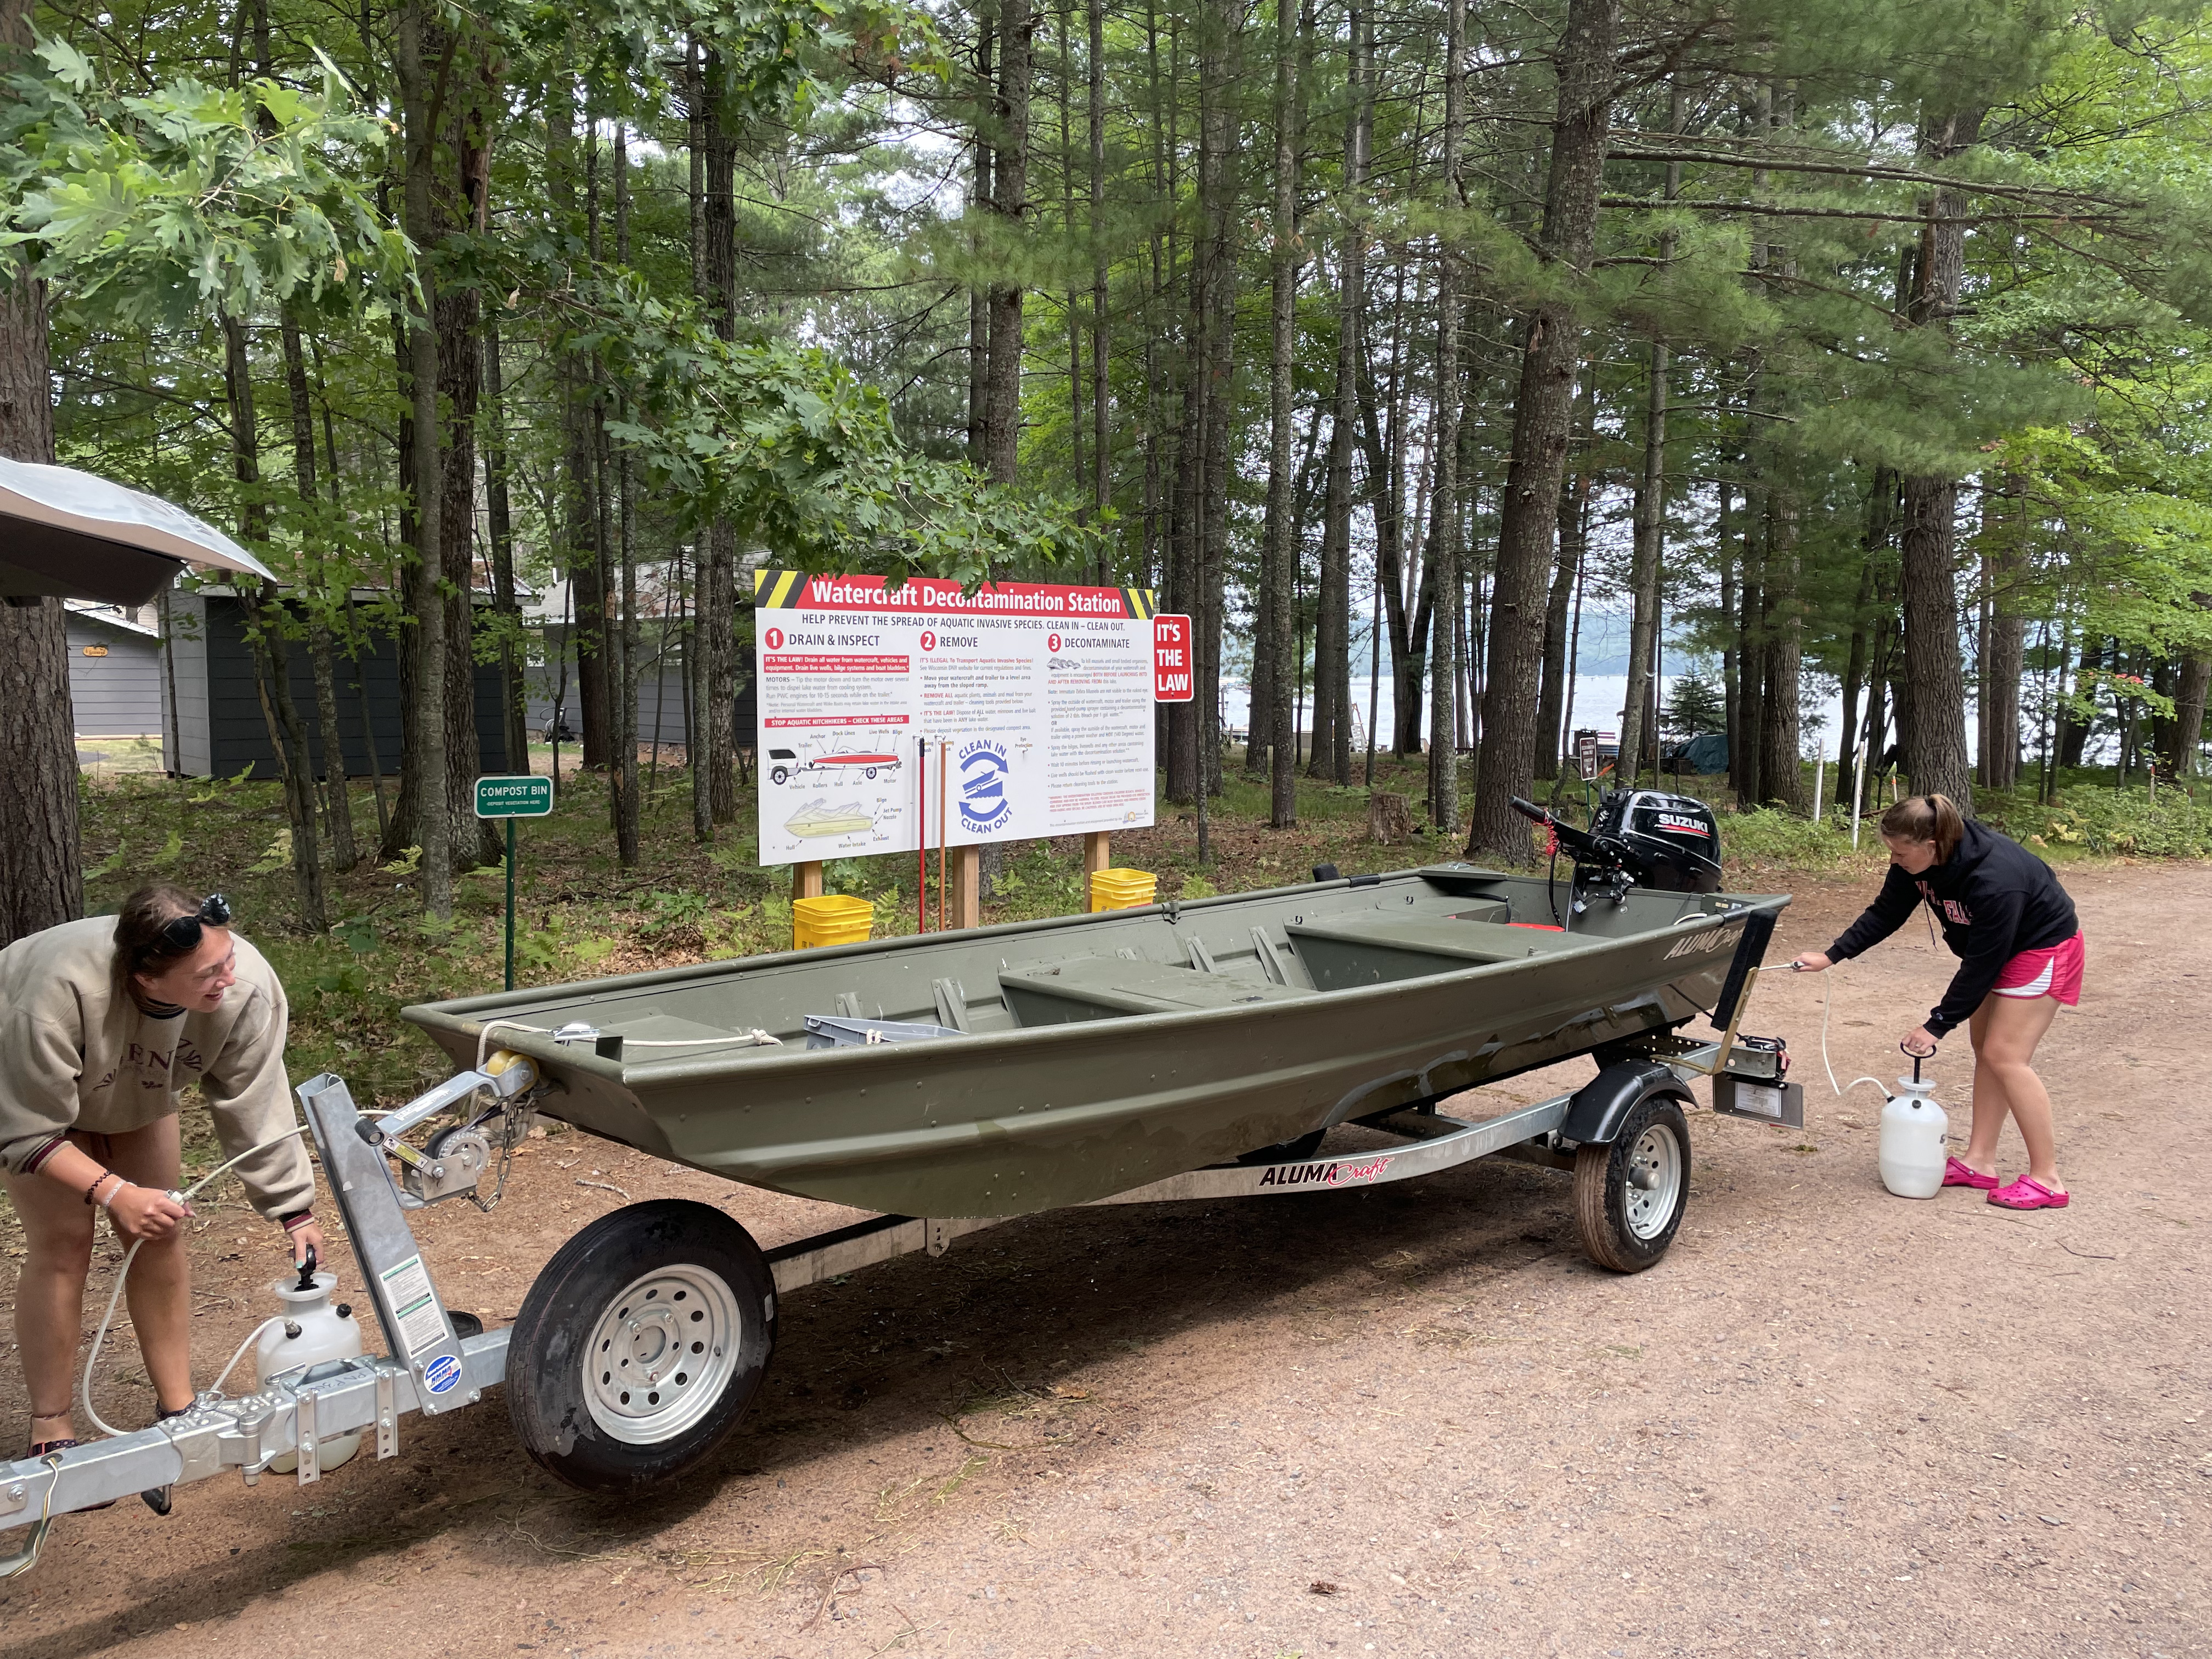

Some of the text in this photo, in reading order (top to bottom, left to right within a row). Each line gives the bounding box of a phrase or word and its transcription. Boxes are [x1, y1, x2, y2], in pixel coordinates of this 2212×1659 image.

[812, 582, 917, 606] Watercraft
[1069, 592, 1120, 613] Station
[802, 614, 825, 624] HELP
[829, 614, 869, 625] PREVENT
[872, 616, 888, 625] THE
[891, 617, 924, 626] SPREAD
[927, 618, 937, 627] OF
[940, 618, 974, 628] AQUATIC
[977, 619, 1012, 628] INVASIVE
[1014, 620, 1044, 629] SPECIES.
[1047, 621, 1069, 629] CLEAN
[1072, 622, 1079, 630] IN
[1087, 622, 1108, 630] CLEAN
[1110, 622, 1125, 630] OUT.
[770, 630, 880, 647] 1 DRAIN & INSPECT
[924, 634, 978, 648] 2 REMOVE
[1157, 624, 1181, 642] IT'S
[1051, 636, 1130, 650] 3 DECONTAMINATE
[1157, 649, 1182, 667] THE
[1158, 674, 1188, 691] LAW
[958, 740, 1007, 759] CLEAN IN
[481, 786, 548, 797] COMPOST BIN
[961, 807, 1012, 833] CLEAN OUT
[1658, 814, 1708, 833] SUZUKI
